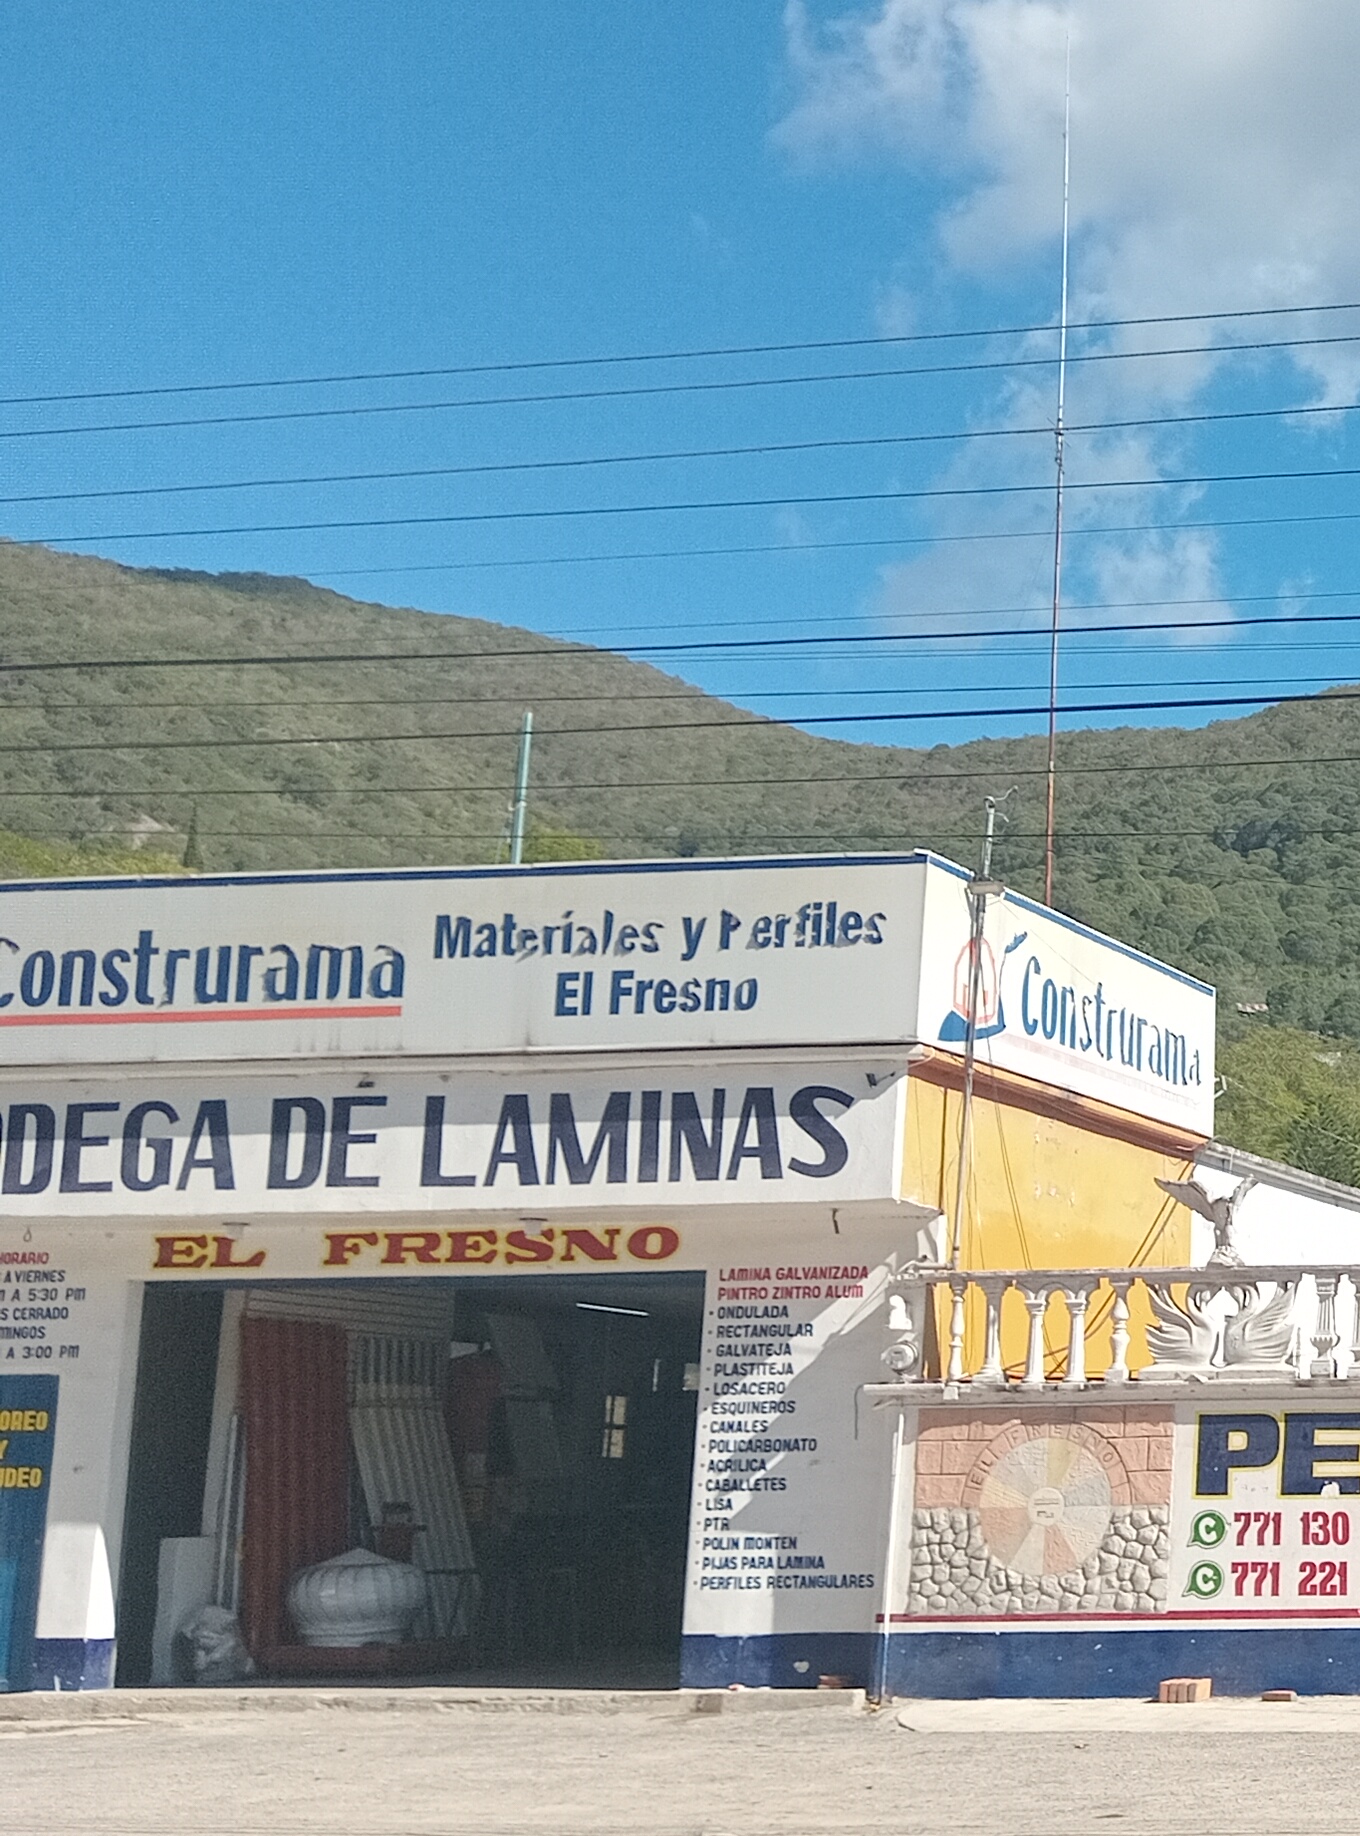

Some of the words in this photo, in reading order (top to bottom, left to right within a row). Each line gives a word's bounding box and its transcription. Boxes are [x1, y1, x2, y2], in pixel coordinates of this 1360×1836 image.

[681, 916, 707, 961] y
[719, 901, 887, 951] Perfiles
[554, 971, 593, 1017] El
[609, 970, 758, 1015] Fresno
[1022, 956, 1201, 1086] Construrama
[0, 1097, 235, 1195] DEGA
[267, 1096, 388, 1189] DE
[420, 1085, 855, 1187] LAMINAS
[152, 1235, 266, 1269] EL
[323, 1226, 681, 1265] FRESNO
[3, 1270, 12, 1283] A
[15, 1269, 66, 1283] VIERNES
[719, 1268, 771, 1282] LAMINA
[775, 1266, 869, 1280] GALVANIZADA
[11, 1288, 20, 1302] A
[28, 1287, 58, 1302] 5:30
[65, 1287, 86, 1301] PM
[717, 1287, 768, 1301] PINTRO
[772, 1286, 821, 1300] ZINTRO
[825, 1285, 864, 1298] ALUM
[13, 1306, 69, 1321] CERRADO
[717, 1305, 789, 1319] ONDULADA
[716, 1323, 814, 1338] RECTANGULAR
[5, 1346, 15, 1359] A
[22, 1345, 52, 1359] 3:00
[59, 1344, 80, 1359] PM
[715, 1343, 792, 1358] GALVATEJA
[714, 1363, 794, 1377] PLASTITEJA
[713, 1382, 786, 1396] LOSACERO
[711, 1400, 796, 1415] ESQUINEROS
[710, 1420, 769, 1434] CANALES
[708, 1438, 818, 1453] POLICARBONATO
[707, 1458, 767, 1472] ACRILICA
[705, 1477, 787, 1491] CABALLETES
[705, 1498, 733, 1511] LISA
[703, 1517, 730, 1531] PTR
[1233, 1511, 1282, 1547] 771
[1300, 1511, 1350, 1546] 130
[702, 1537, 740, 1550] POLIN
[743, 1536, 798, 1550] MONTEN
[702, 1557, 737, 1570] PIJAS
[741, 1557, 774, 1570] PARA
[777, 1556, 825, 1569] LAMINA
[700, 1576, 761, 1590] PERFILES
[766, 1574, 875, 1588] RECTANGULARES
[1230, 1561, 1281, 1598] 771
[1298, 1561, 1348, 1596] 221
